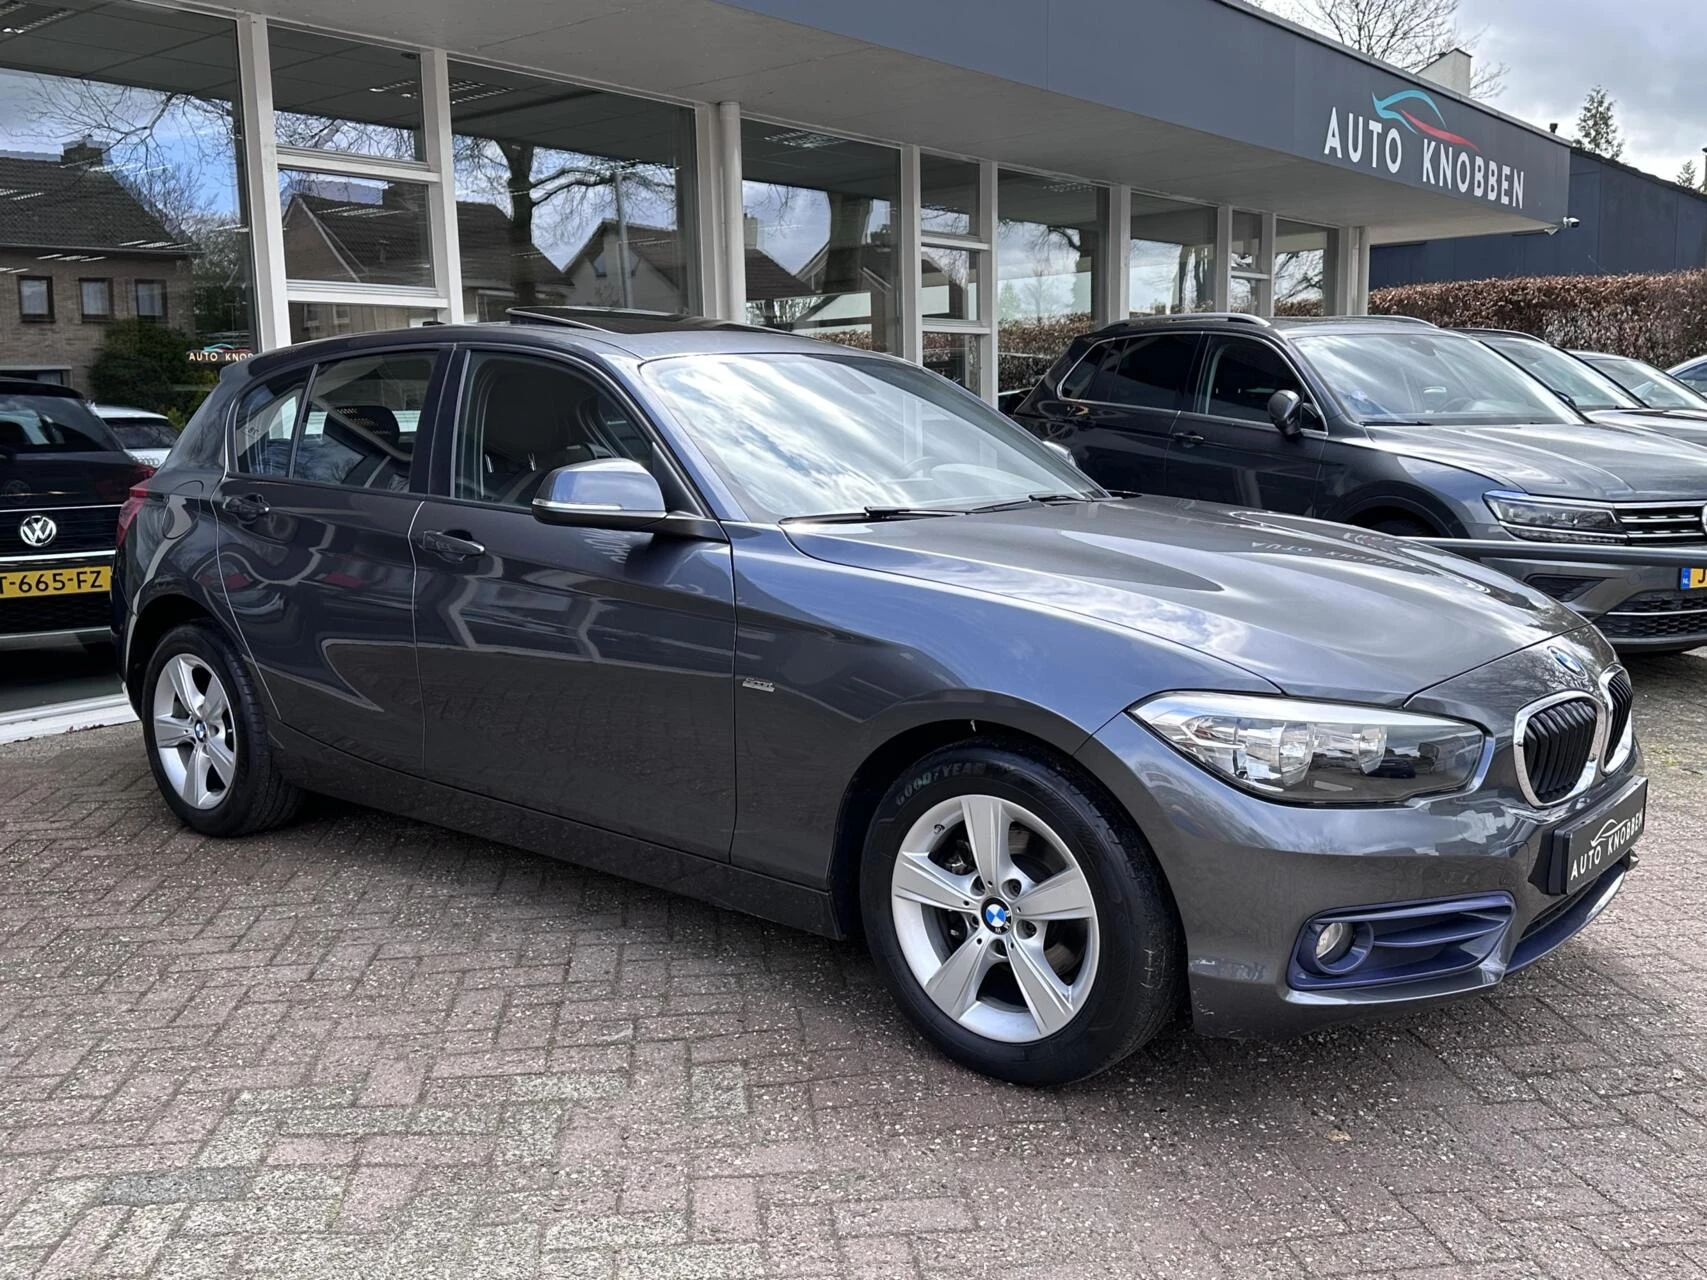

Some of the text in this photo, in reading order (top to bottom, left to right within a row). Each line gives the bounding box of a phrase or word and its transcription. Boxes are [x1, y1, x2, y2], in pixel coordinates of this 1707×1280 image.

[1324, 106, 1525, 210] AUTO KNOBBEN
[188, 352, 218, 362] AUTO
[1570, 806, 1644, 881] AUTO KNOBBEN
